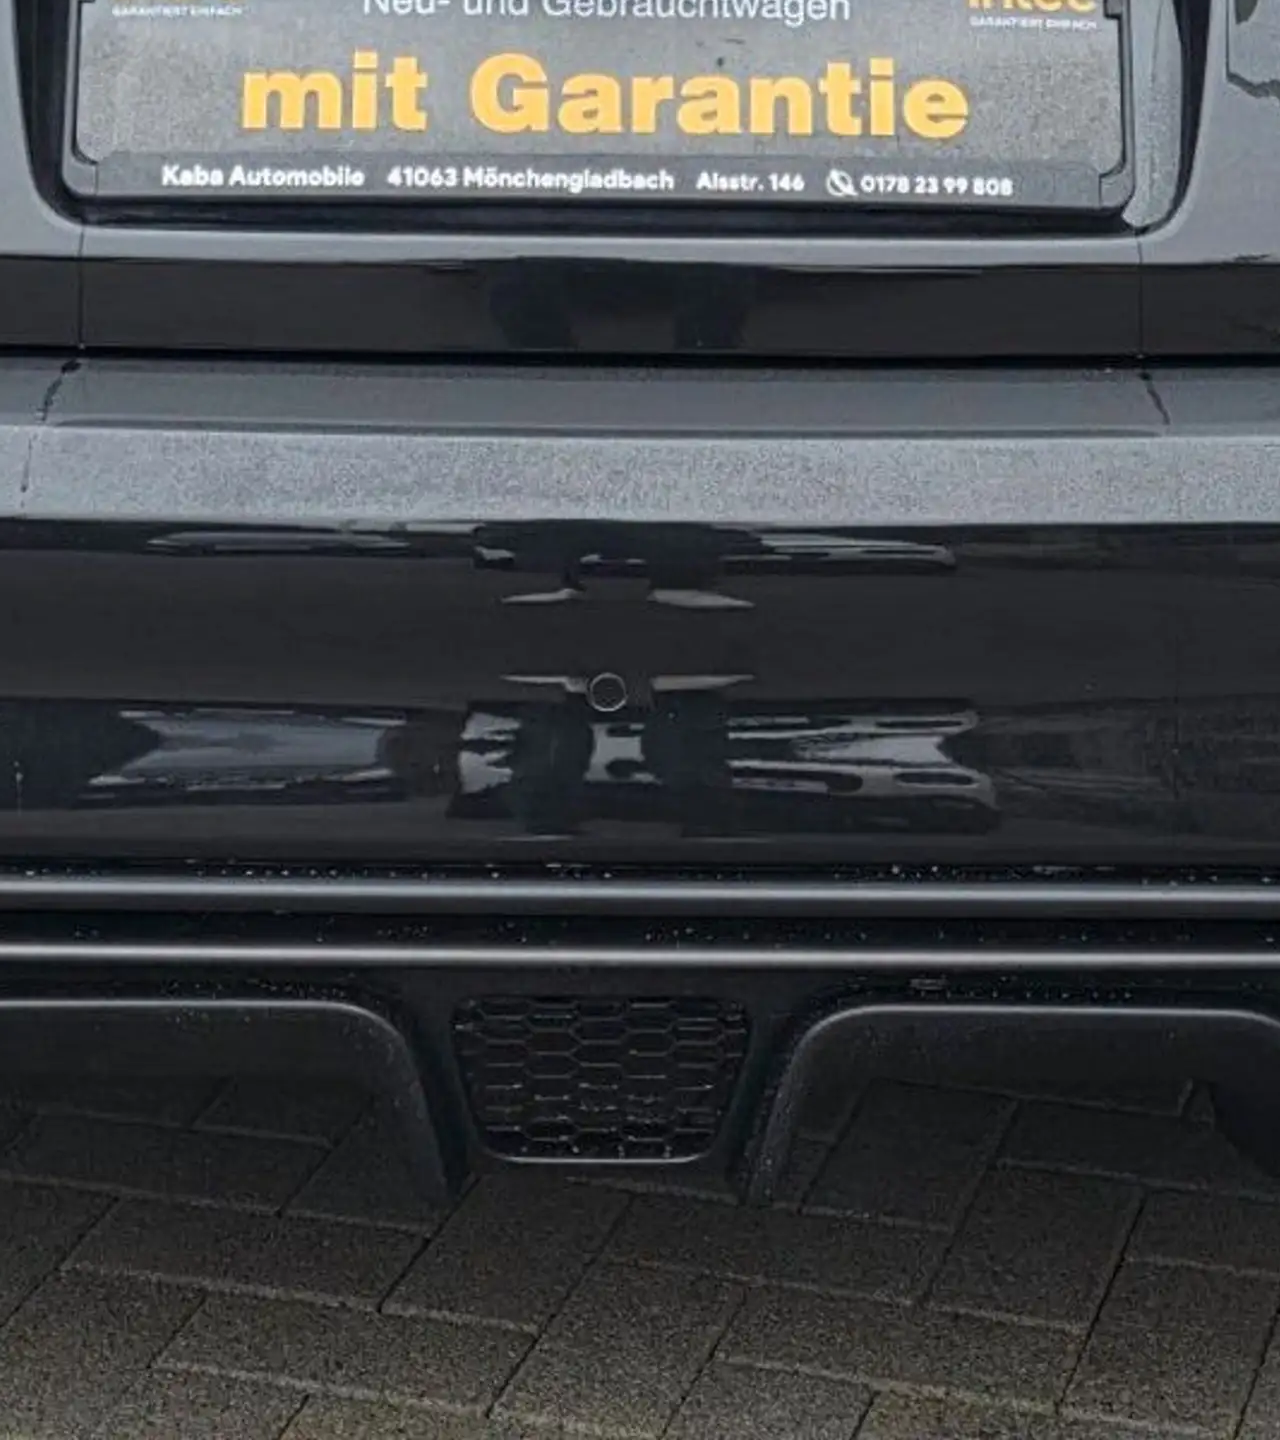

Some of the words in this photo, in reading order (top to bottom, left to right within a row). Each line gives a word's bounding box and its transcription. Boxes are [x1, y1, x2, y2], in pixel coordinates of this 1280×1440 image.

[242, 50, 428, 131] mit
[470, 51, 968, 139] Garantie
[161, 165, 224, 187] Kaba
[228, 165, 366, 188] Automobile
[387, 167, 458, 188] 41063
[463, 166, 675, 194] Mönchengladbach
[769, 173, 805, 192] 146
[859, 175, 910, 194] 0178
[943, 176, 969, 195] 99
